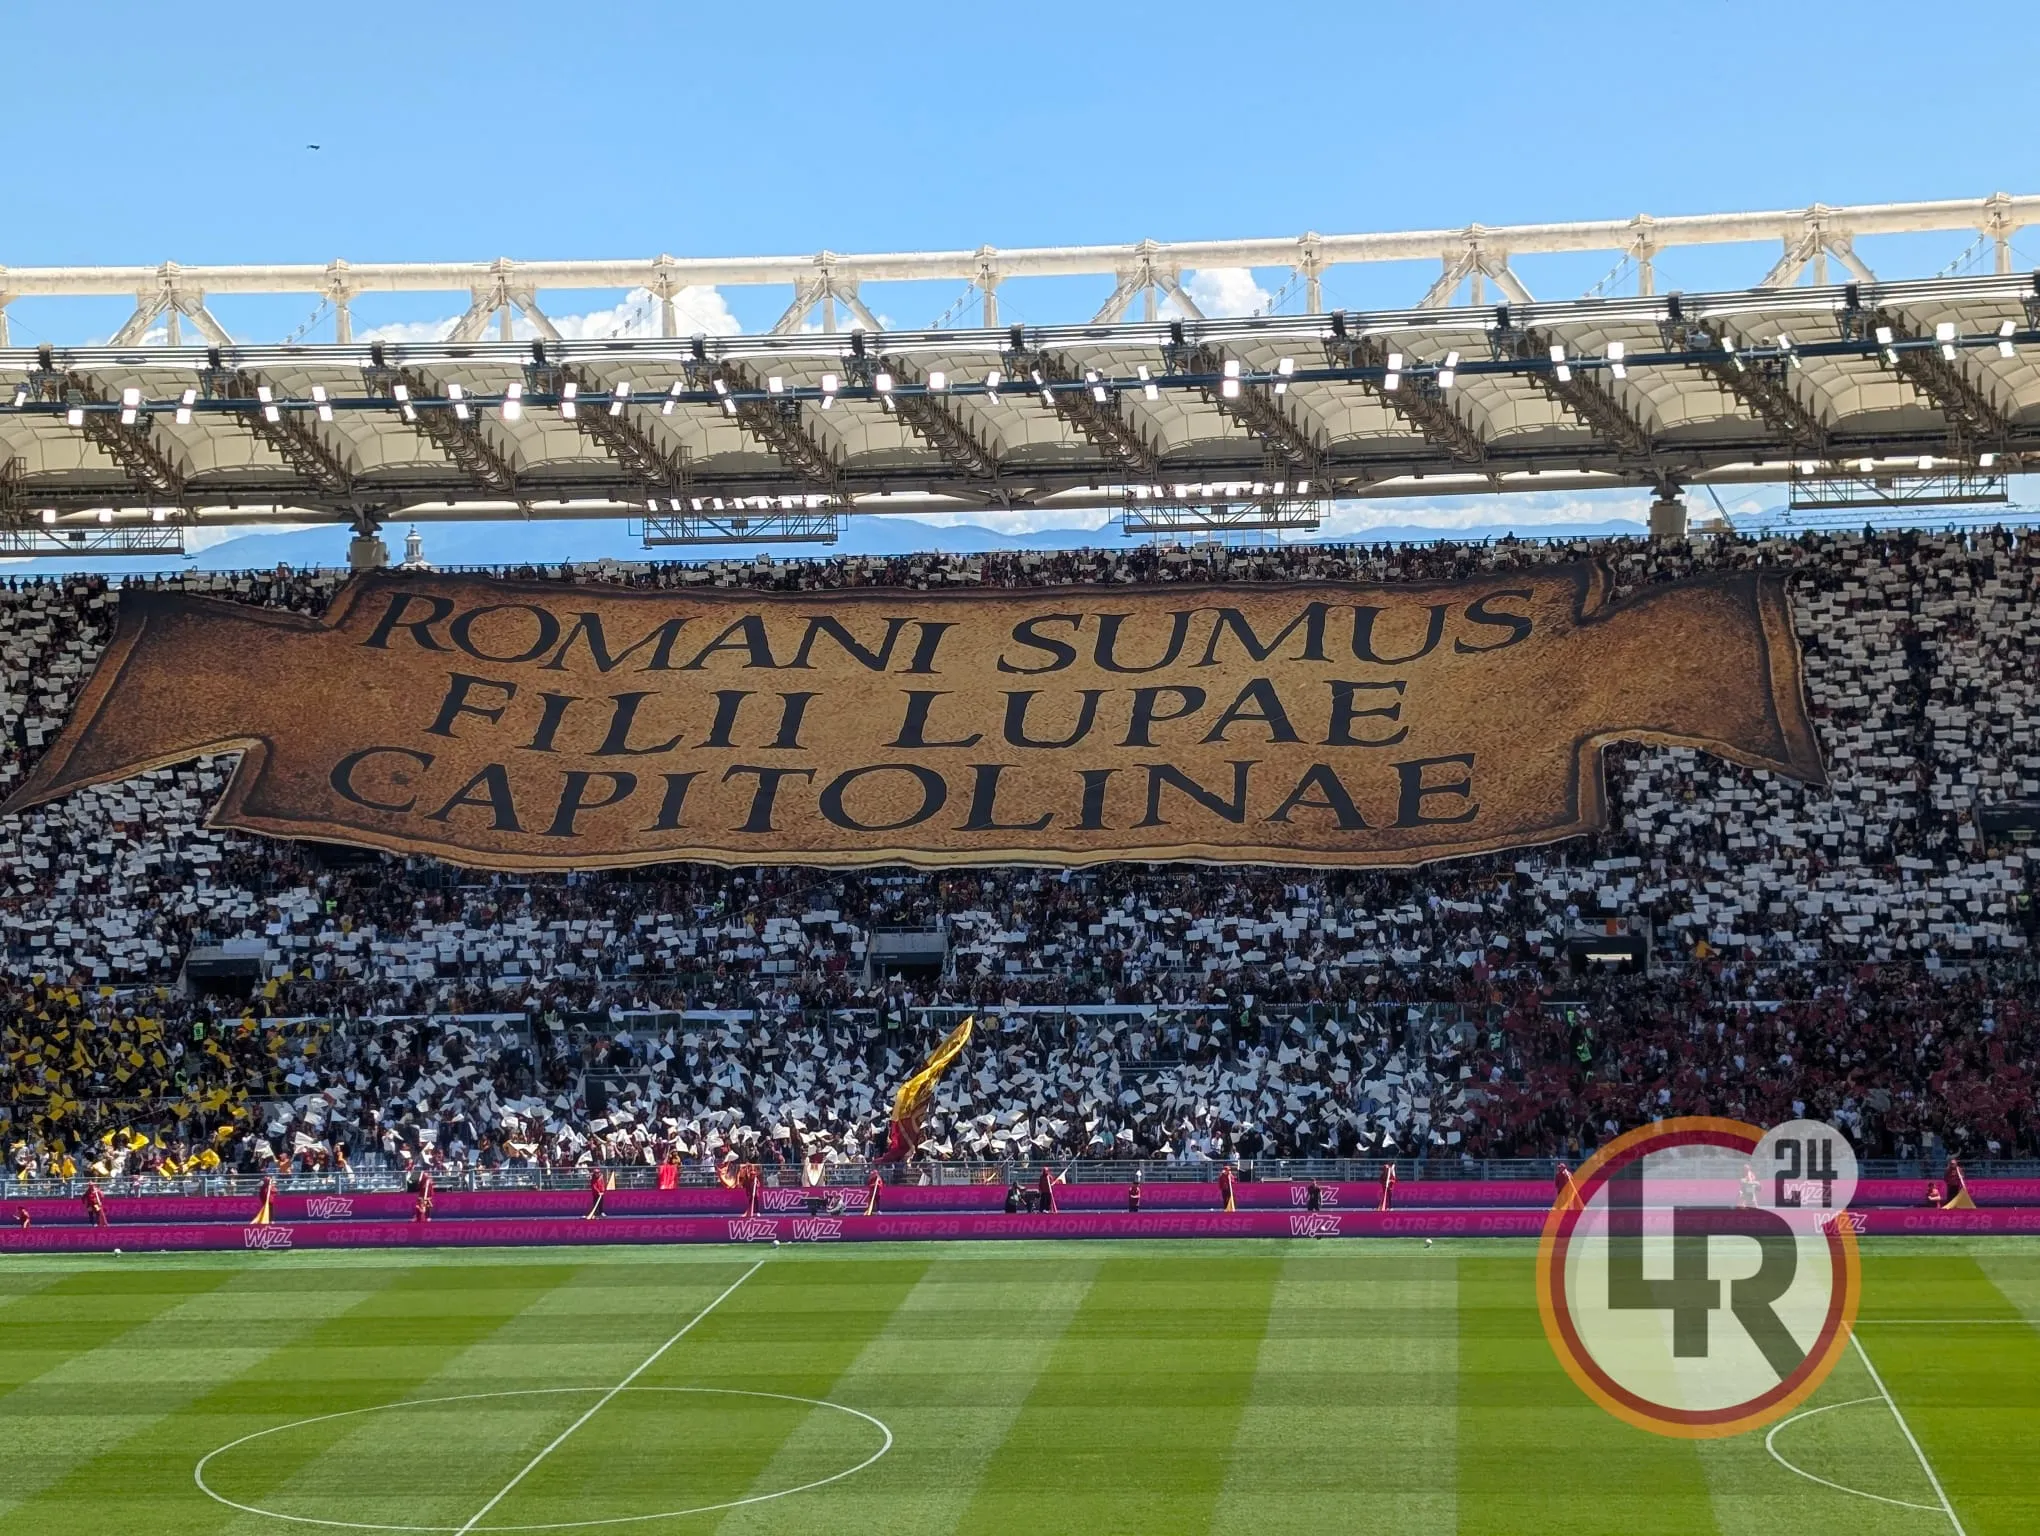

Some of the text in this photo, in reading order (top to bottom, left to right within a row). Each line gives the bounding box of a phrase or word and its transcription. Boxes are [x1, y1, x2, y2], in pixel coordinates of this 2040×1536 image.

[354, 588, 1534, 674] ROMANI SUMUS
[423, 671, 1409, 756] FILII LUPAE
[329, 745, 1481, 837] CAPITOLINAE
[877, 1221, 933, 1236] OLTRE
[973, 1218, 1097, 1233] DESTINAZIONI
[1120, 1218, 1191, 1233] TARIFFE
[1194, 1217, 1254, 1232] BASSE
